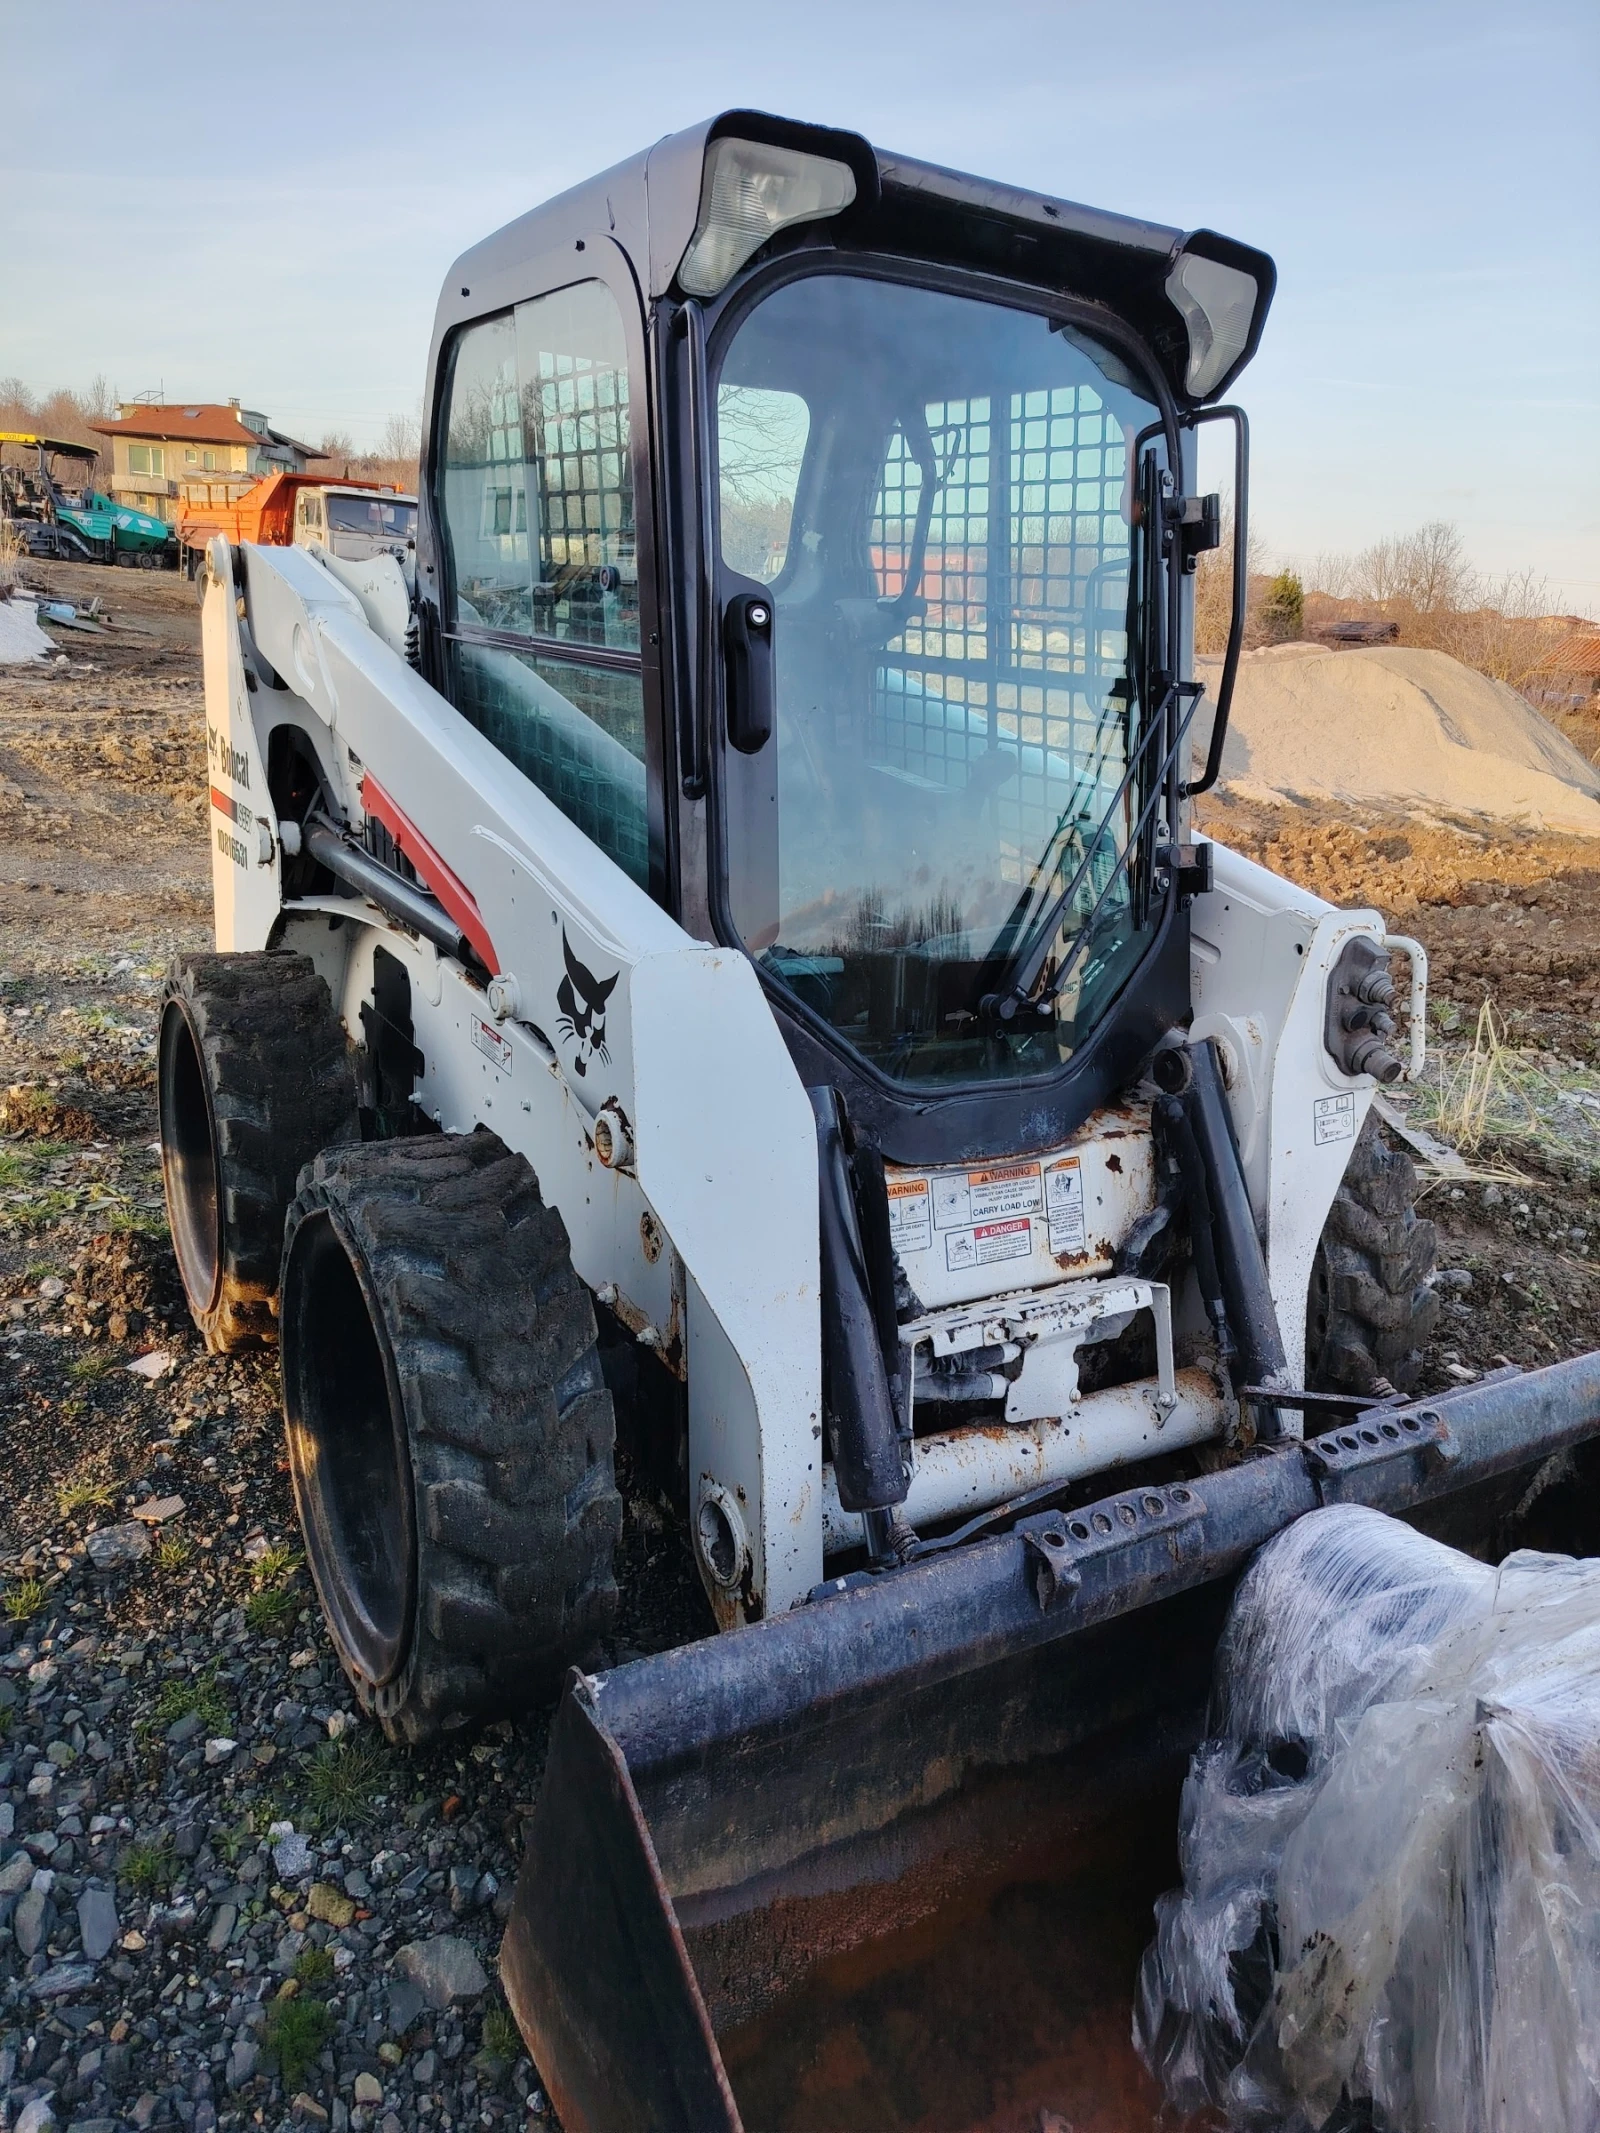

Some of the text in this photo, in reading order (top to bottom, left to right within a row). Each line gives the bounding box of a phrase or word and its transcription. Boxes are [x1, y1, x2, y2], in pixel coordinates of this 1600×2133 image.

[220, 735, 250, 791] Bobcat
[1053, 1160, 1077, 1168] ARNING
[989, 1166, 1030, 1180] WARNING
[973, 1198, 1040, 1216] CARRY LOAD LOW
[990, 1221, 1023, 1235] DANGER
